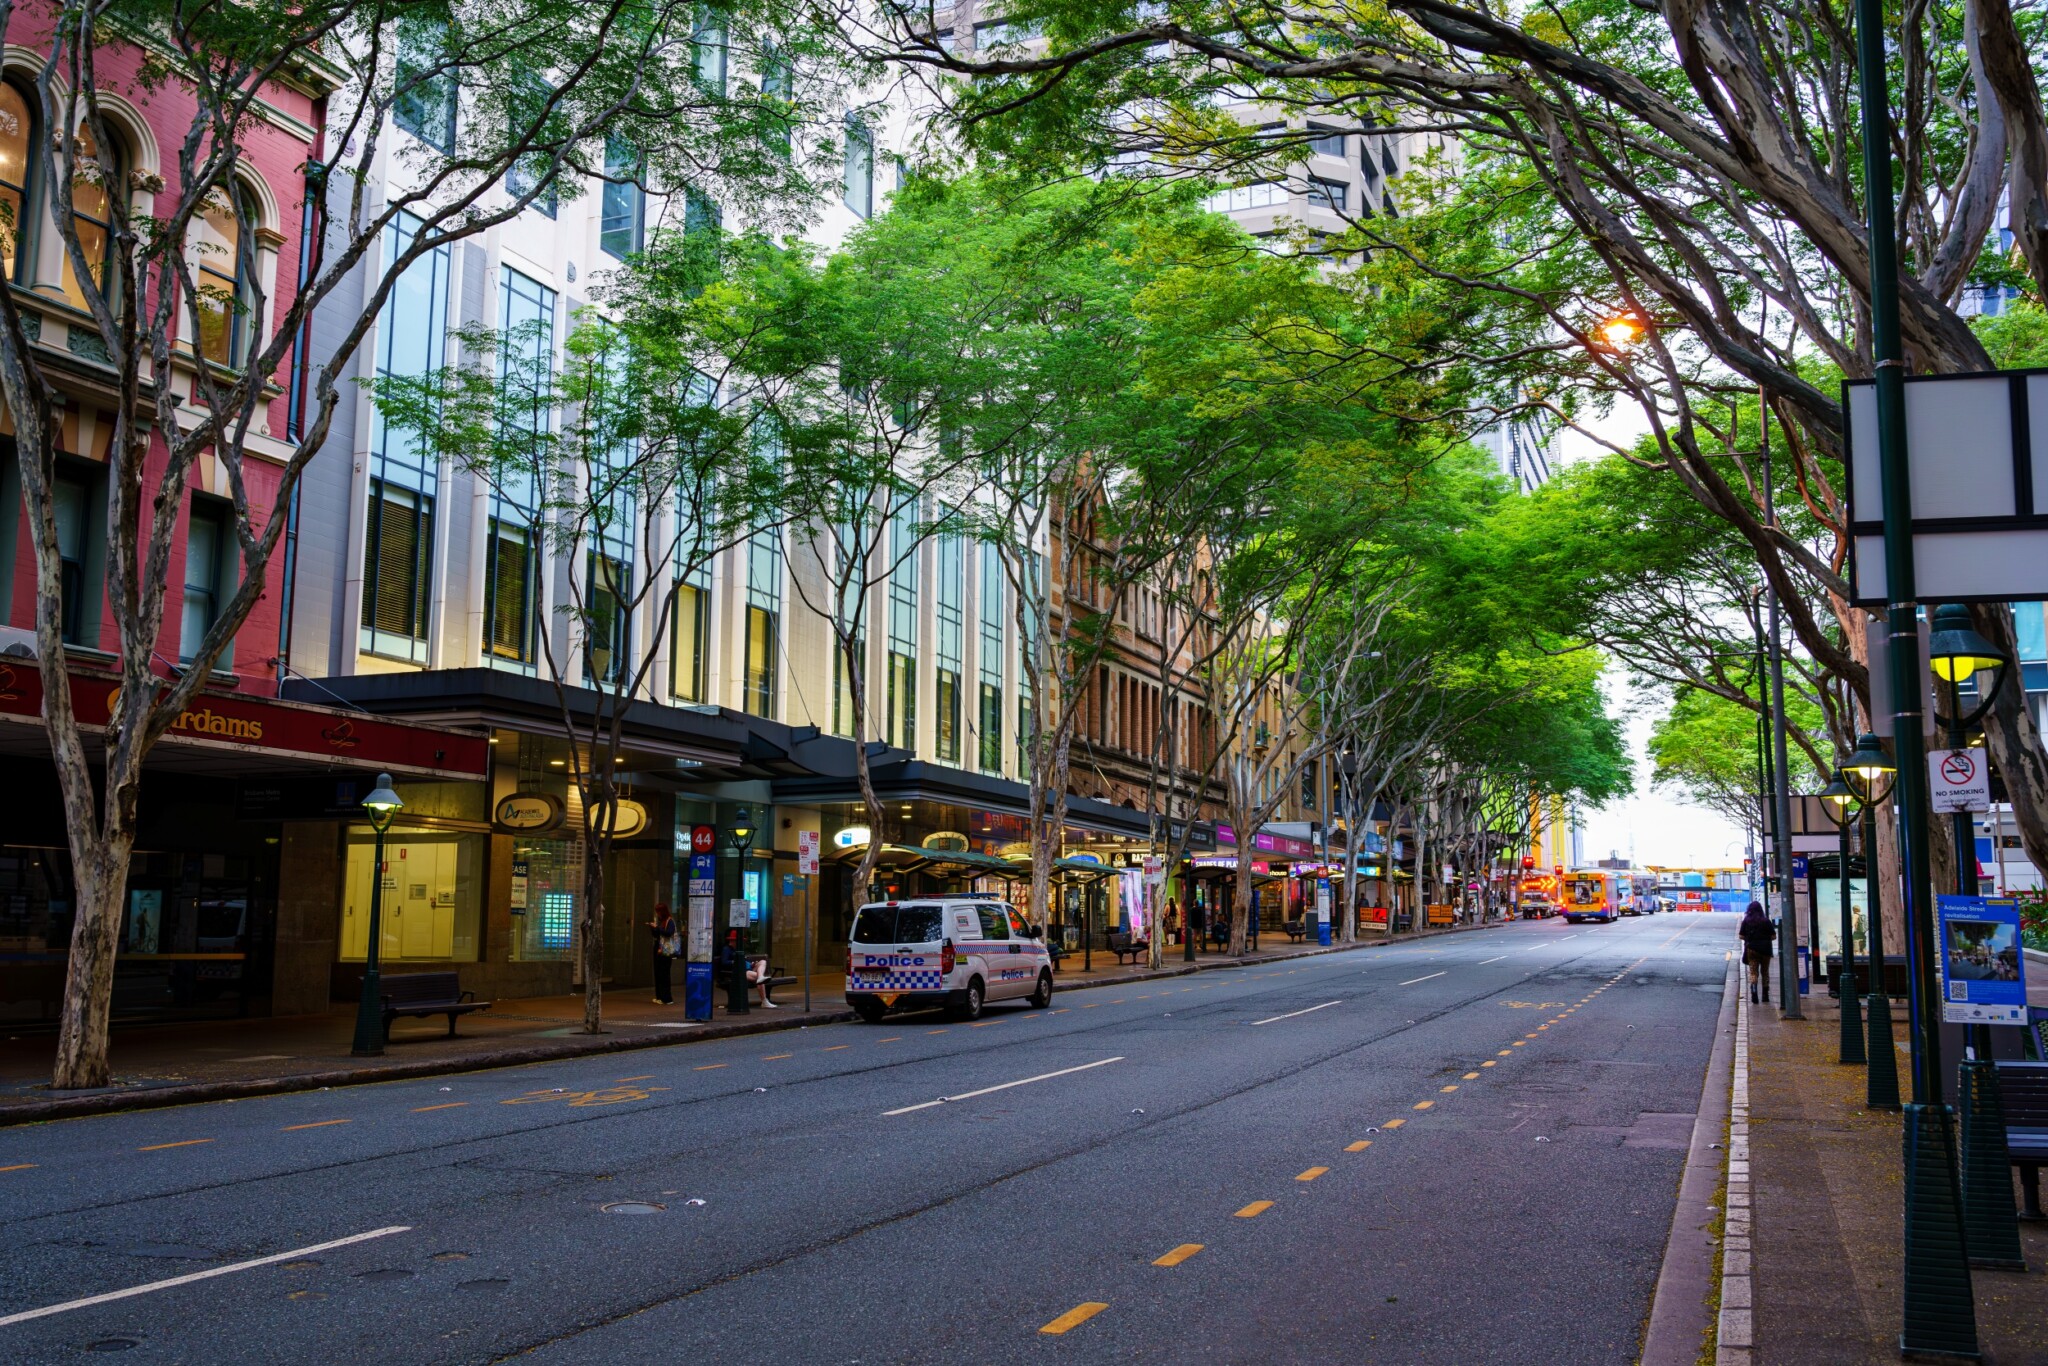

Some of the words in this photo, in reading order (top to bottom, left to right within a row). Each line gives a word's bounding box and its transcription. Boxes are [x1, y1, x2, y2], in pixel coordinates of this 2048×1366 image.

[1949, 788, 1985, 796] SMOKING
[694, 833, 712, 846] 44
[700, 881, 714, 894] 44
[865, 955, 925, 966] Police
[1002, 968, 1024, 981] Police
